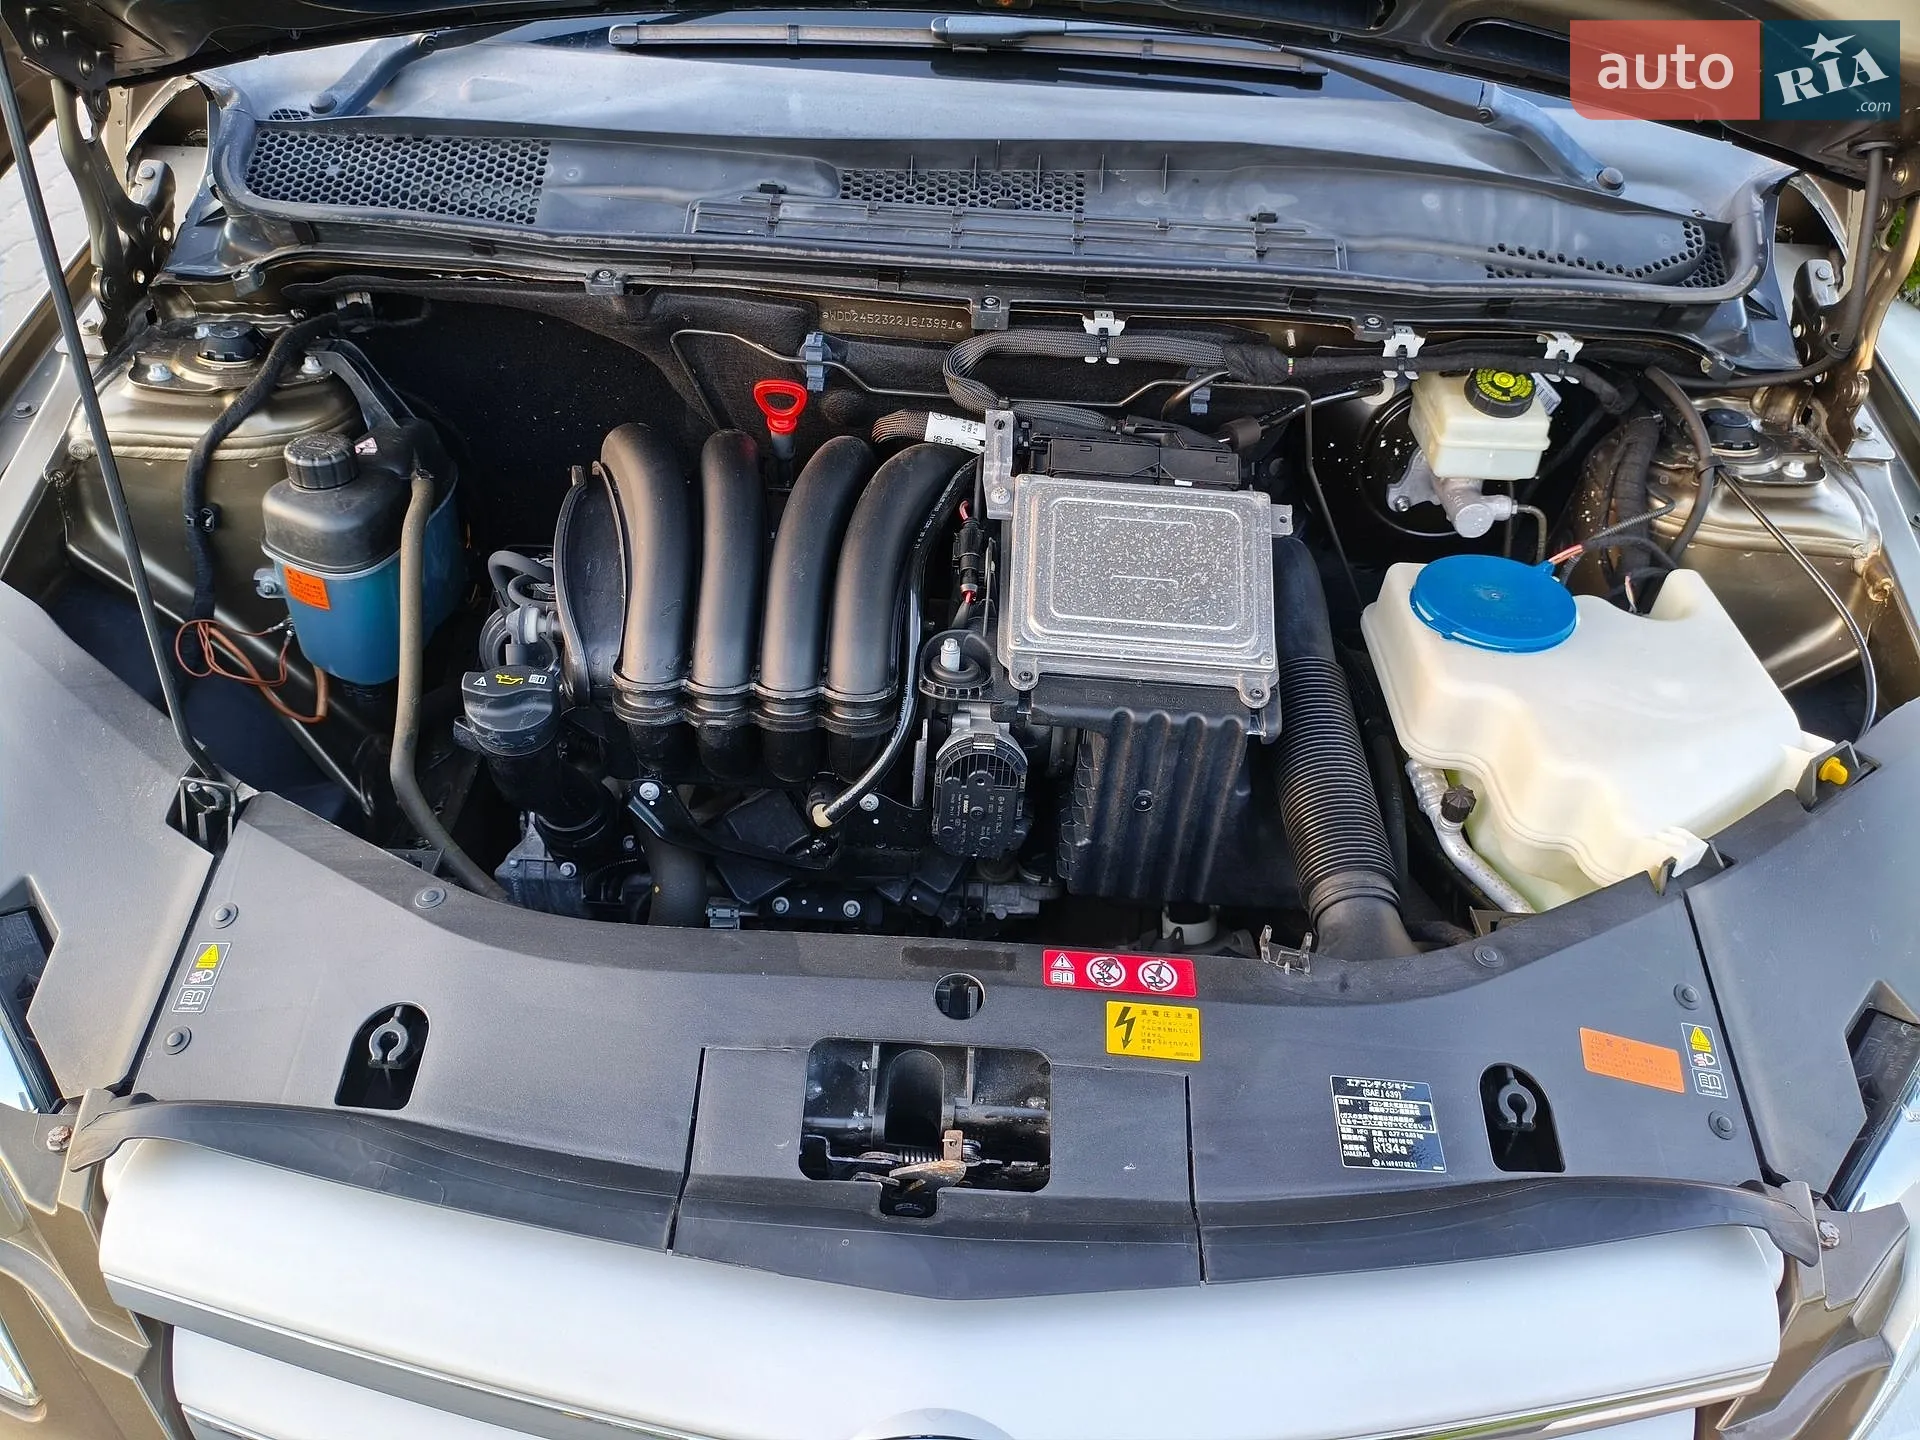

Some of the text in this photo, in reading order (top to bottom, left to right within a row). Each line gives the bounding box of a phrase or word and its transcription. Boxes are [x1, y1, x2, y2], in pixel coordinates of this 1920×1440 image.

[1346, 1078, 1415, 1091] エアコンディショナー
[1363, 1088, 1380, 1097] (SAE
[1385, 1090, 1402, 1099] 639)
[1373, 1142, 1408, 1155] R134a
